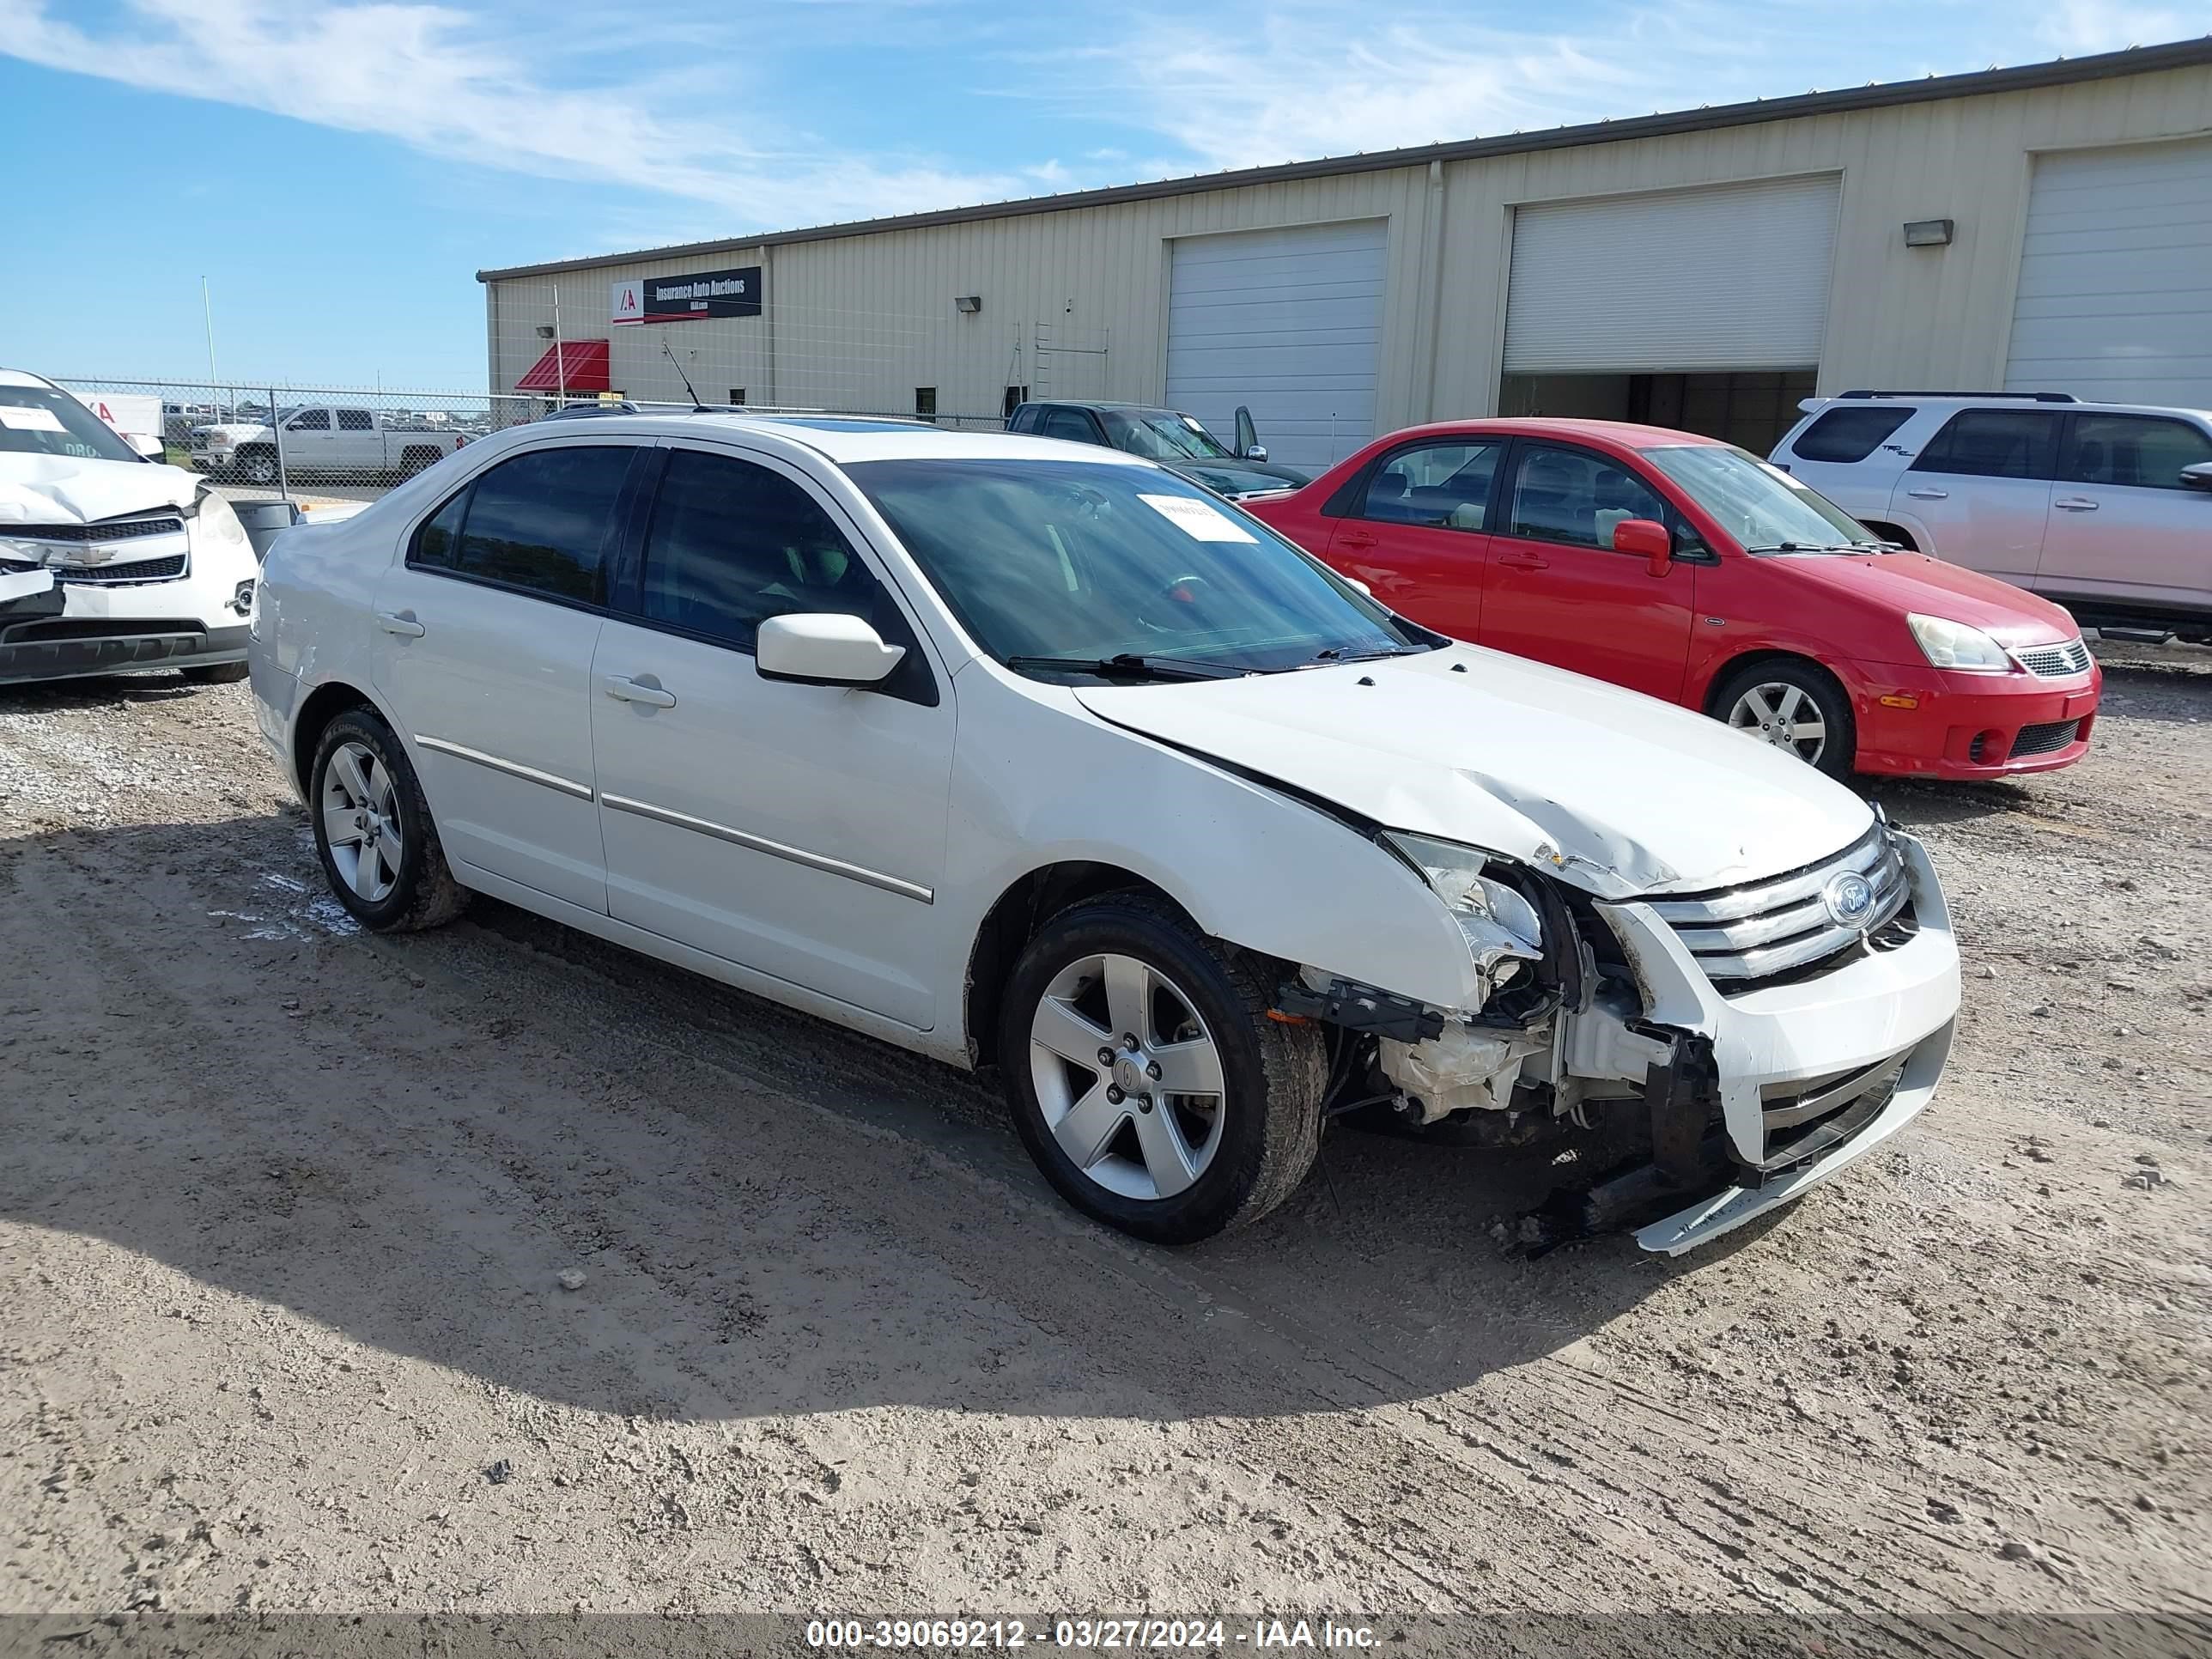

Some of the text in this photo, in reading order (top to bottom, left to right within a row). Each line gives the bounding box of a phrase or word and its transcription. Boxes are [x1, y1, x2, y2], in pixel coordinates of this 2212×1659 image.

[656, 279, 745, 301] Insurance Auto Auctions
[1844, 884, 1869, 910] Ford
